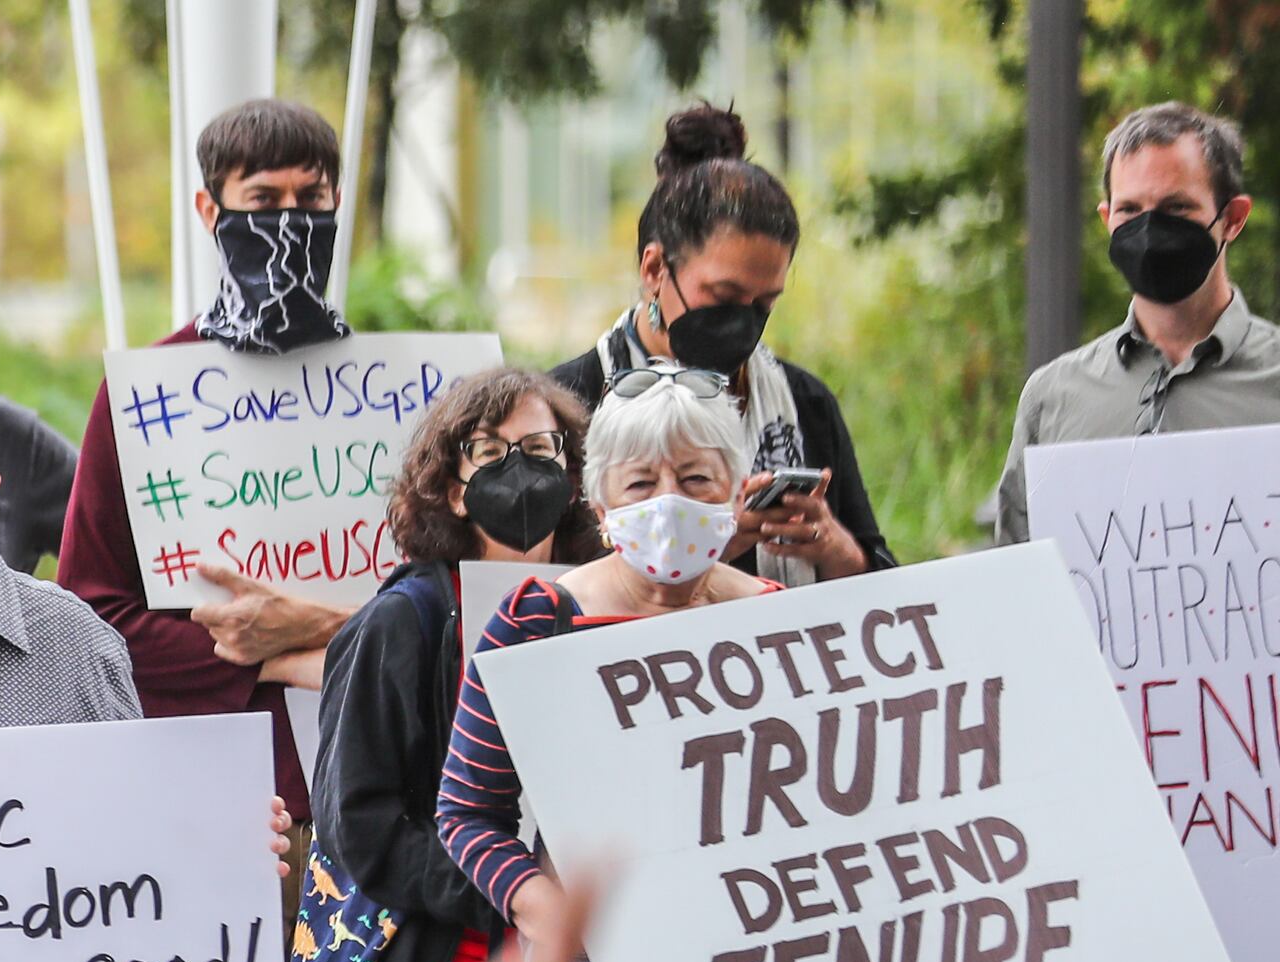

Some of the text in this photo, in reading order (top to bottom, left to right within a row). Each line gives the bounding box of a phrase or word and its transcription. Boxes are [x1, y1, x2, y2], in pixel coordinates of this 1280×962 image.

[597, 603, 945, 730] PROTECT
[680, 676, 1005, 848] TRUTH
[719, 815, 1029, 935] DEFEND
